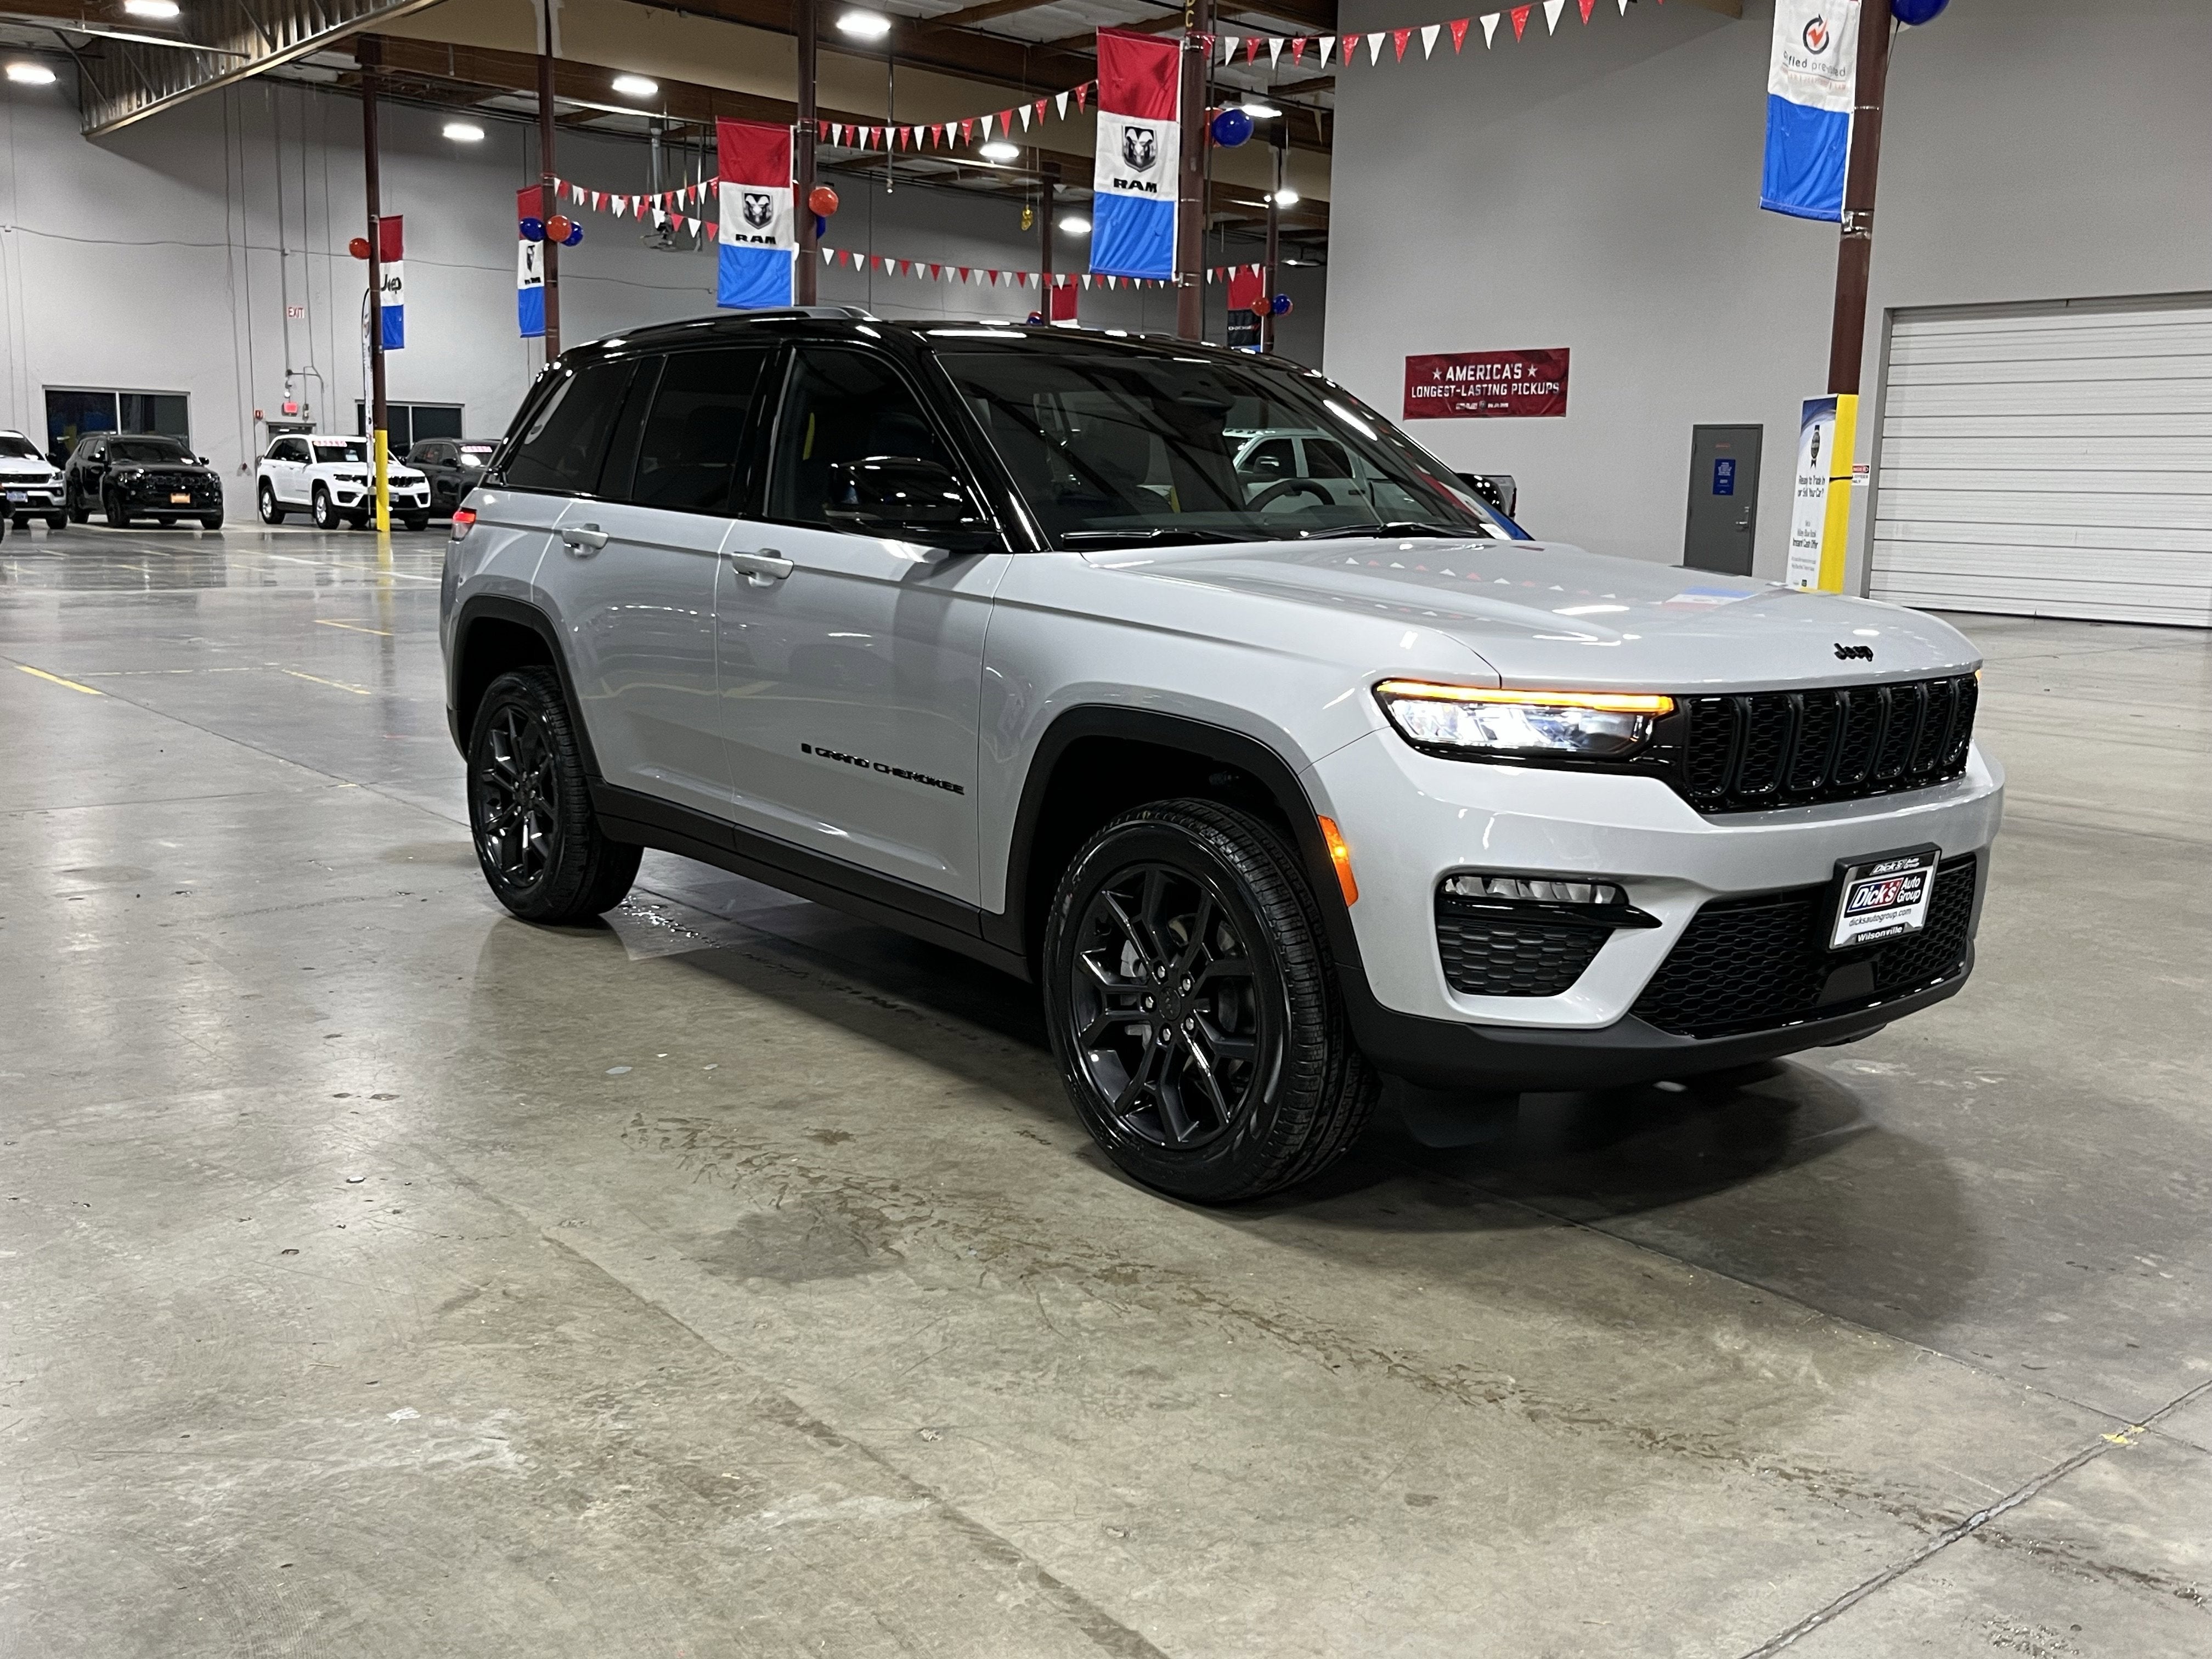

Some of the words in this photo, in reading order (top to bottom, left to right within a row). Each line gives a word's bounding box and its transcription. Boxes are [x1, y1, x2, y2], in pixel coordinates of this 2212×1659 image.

[1113, 177, 1158, 193] RAM
[735, 234, 776, 245] RAM
[288, 307, 303, 318] EXIT
[1445, 363, 1523, 382] AMERICA'S
[1411, 383, 1508, 399] LONGEST-LASTING
[1511, 382, 1560, 396] PICKUPS
[1833, 642, 1874, 662] Jeep
[815, 747, 870, 769] GRAND
[873, 762, 964, 796] CHEROKEE
[1900, 876, 1921, 890] Auto
[1852, 882, 1897, 909] Dick's
[1896, 889, 1921, 904] Group
[1849, 908, 1911, 927] dicksautogroup.com
[1858, 926, 1903, 943] Wilsonville
